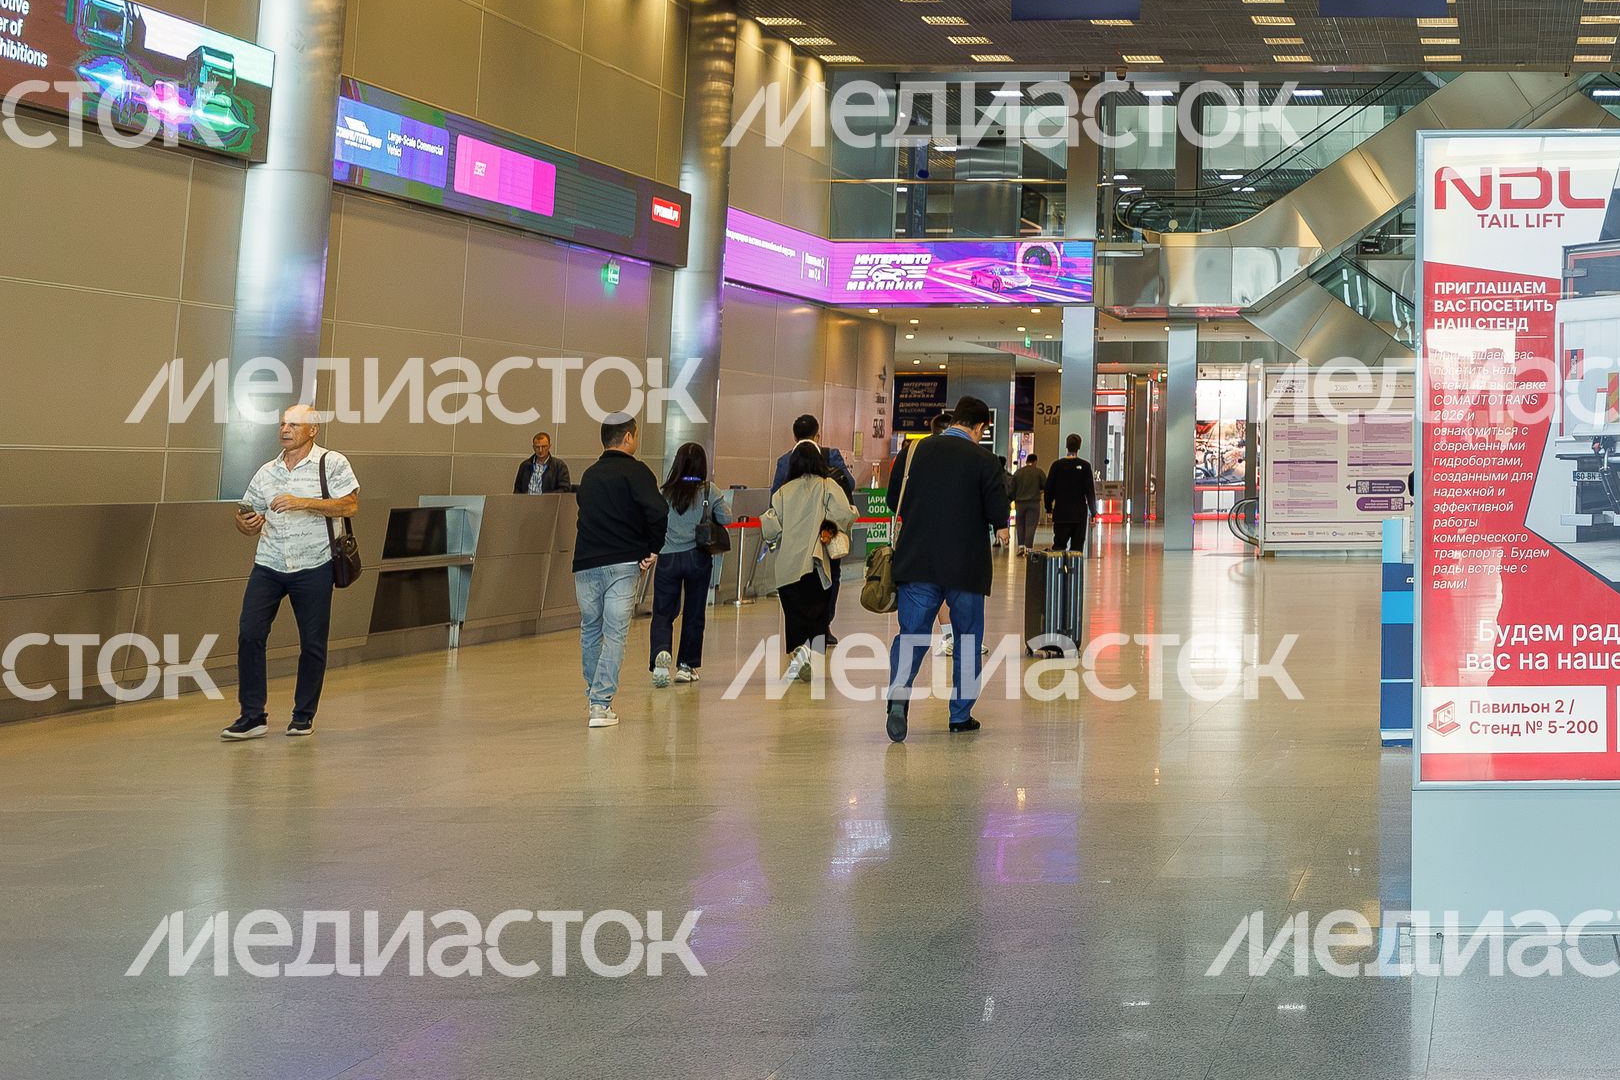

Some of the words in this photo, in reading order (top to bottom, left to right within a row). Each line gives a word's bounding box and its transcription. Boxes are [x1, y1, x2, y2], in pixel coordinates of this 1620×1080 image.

[10, 18, 23, 37] of
[1434, 167, 1605, 210] NDL
[1477, 213, 1519, 228] TAIL
[1526, 213, 1565, 228] LIFT
[855, 253, 932, 265] ИНТЕРАВТО
[846, 280, 923, 290] МЕХАНИКА
[1434, 281, 1546, 296] ПРИГЛАШАЕМ
[1434, 299, 1465, 313] ВАС
[1470, 299, 1554, 312] ПОСЕТИТЬ
[1434, 317, 1473, 332] НАШ
[1476, 317, 1528, 332] СТЕНД
[1434, 395, 1538, 406] COMAUTOTRANS
[1434, 410, 1464, 420] 2026
[1433, 425, 1518, 436] ознакомиться
[1433, 442, 1525, 453] современными
[1433, 455, 1523, 468] гидробортами,
[1433, 471, 1508, 483] созданными
[1511, 473, 1533, 483] для
[1433, 486, 1495, 498] надежной
[1497, 489, 1505, 497] и
[1433, 501, 1514, 514] эффективной
[1433, 517, 1478, 529] работы
[1433, 533, 1528, 544] коммерческого
[1433, 548, 1506, 559] транспорта.
[1511, 547, 1550, 559] Будем
[1433, 564, 1465, 576] рады
[1468, 565, 1517, 576] встрече
[1433, 579, 1467, 589] вами!
[1478, 620, 1564, 646] Будем
[1466, 653, 1511, 671] вас
[1519, 652, 1549, 670] на
[1469, 700, 1550, 715] Павильон
[1554, 700, 1565, 714] 2
[1469, 720, 1520, 736] Стенд
[1525, 720, 1543, 735] №
[1548, 720, 1598, 735] 5-200
